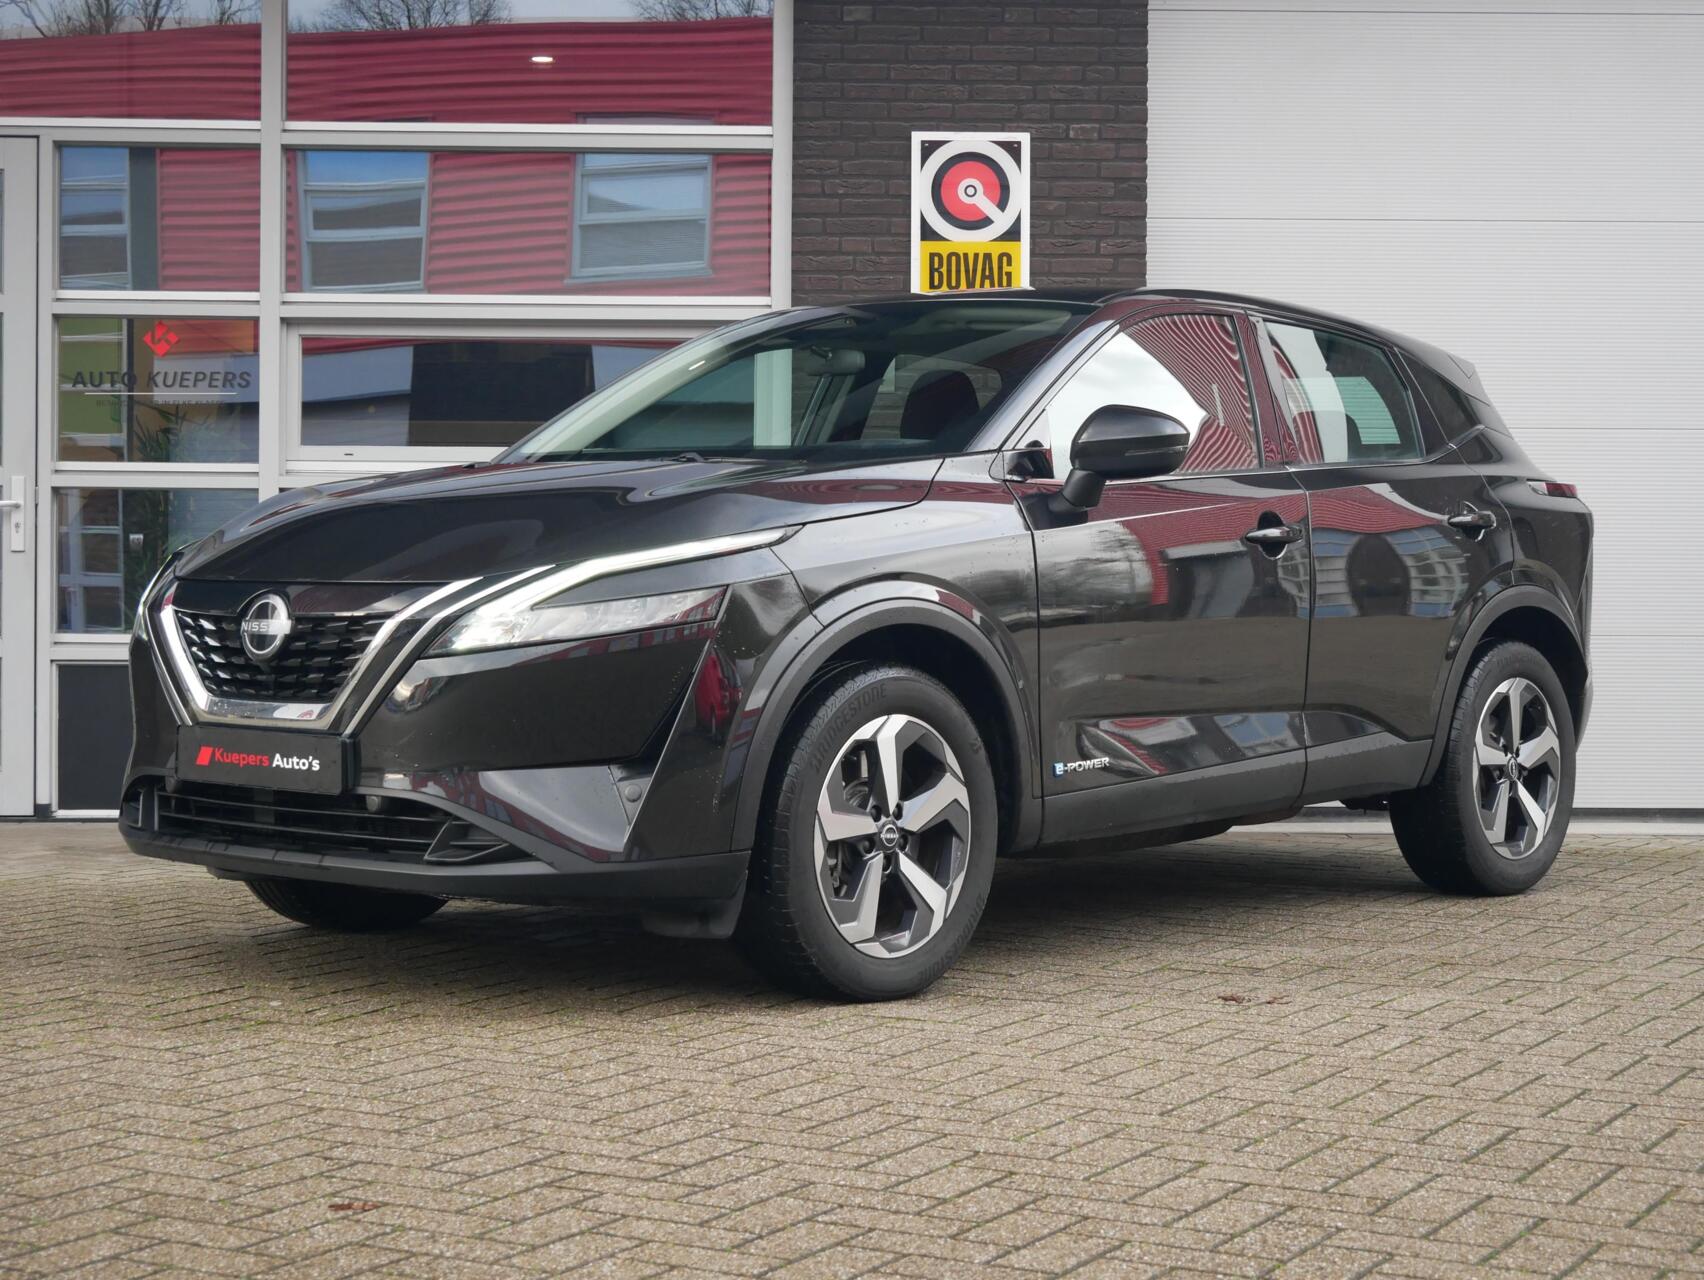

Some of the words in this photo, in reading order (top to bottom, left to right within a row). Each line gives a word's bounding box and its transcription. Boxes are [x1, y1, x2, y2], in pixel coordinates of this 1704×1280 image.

[929, 252, 1012, 290] BOVAG
[72, 371, 137, 388] AUTO
[147, 371, 252, 389] KUEPERS
[214, 747, 270, 768] Kuepers
[272, 753, 321, 771] Auto's
